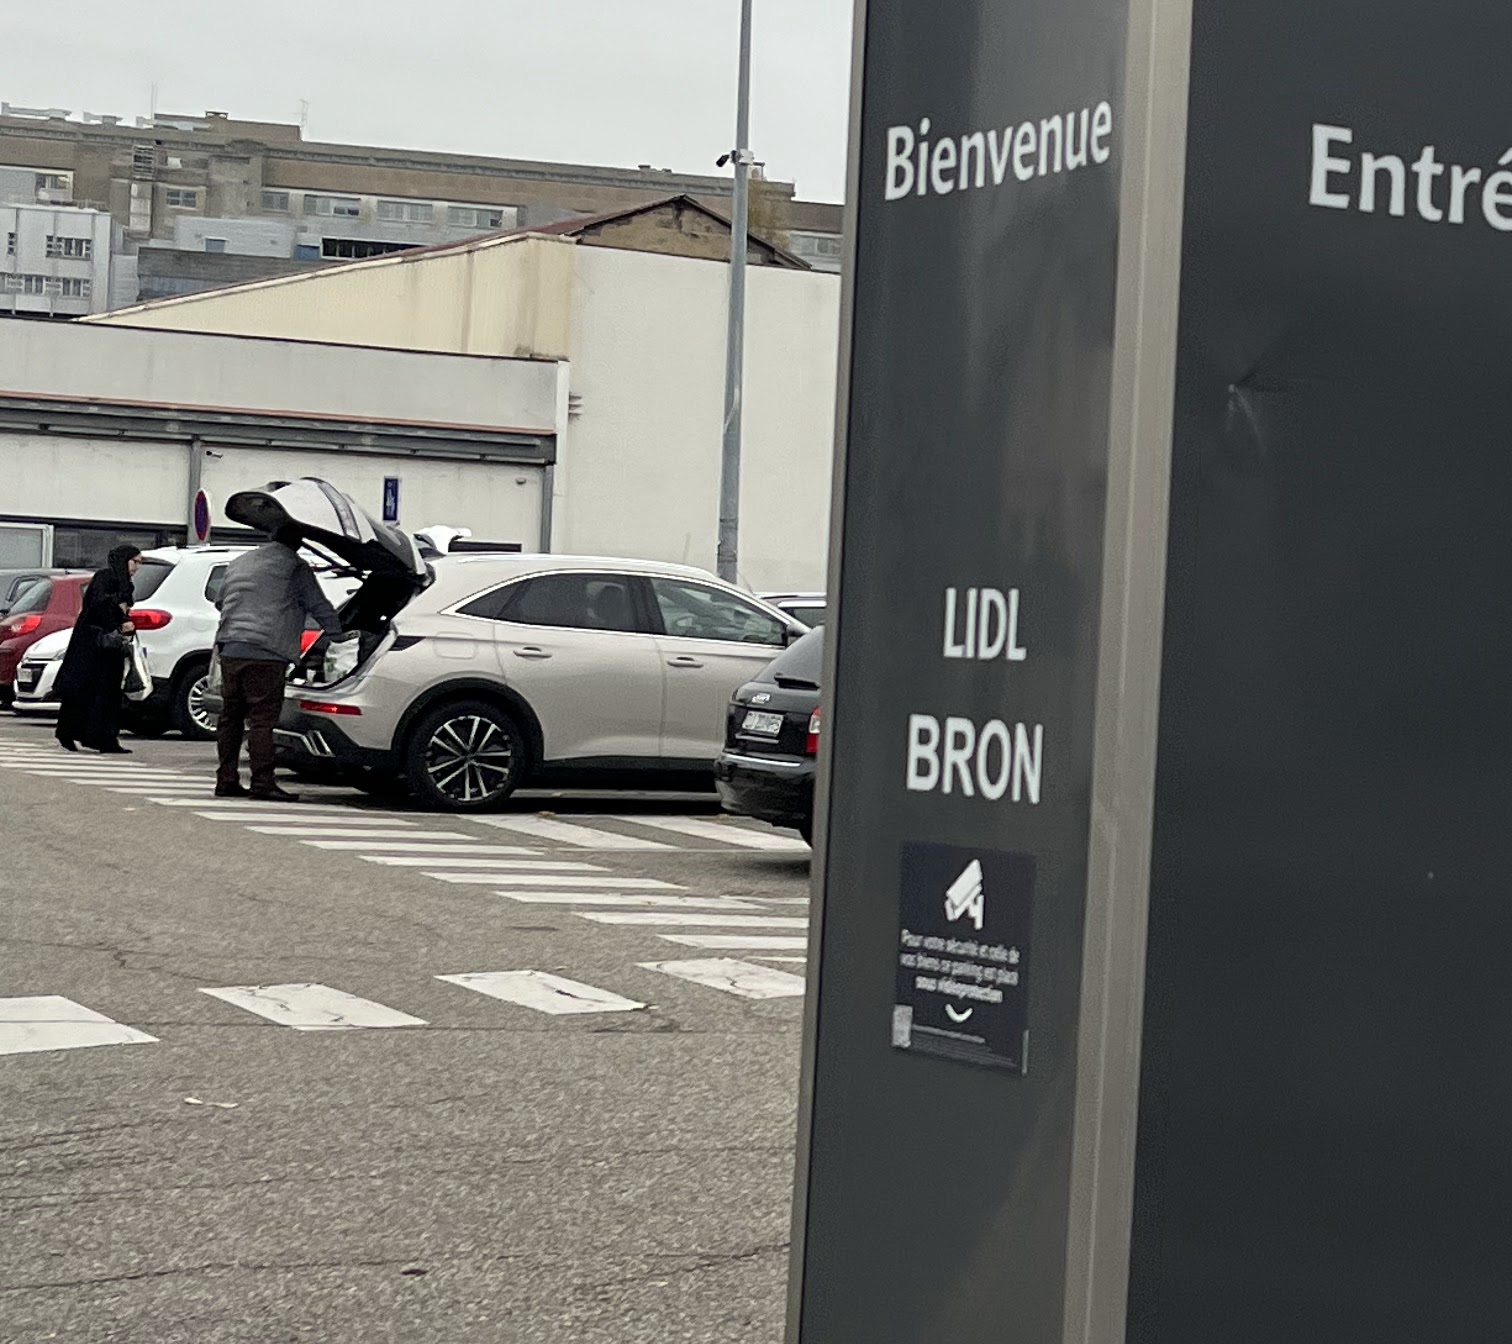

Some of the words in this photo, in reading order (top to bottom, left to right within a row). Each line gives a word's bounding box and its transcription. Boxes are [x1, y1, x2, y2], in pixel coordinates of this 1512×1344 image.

[884, 100, 1112, 201] Bienvenue
[943, 587, 1027, 661] LIDL
[906, 713, 1044, 805] BRON
